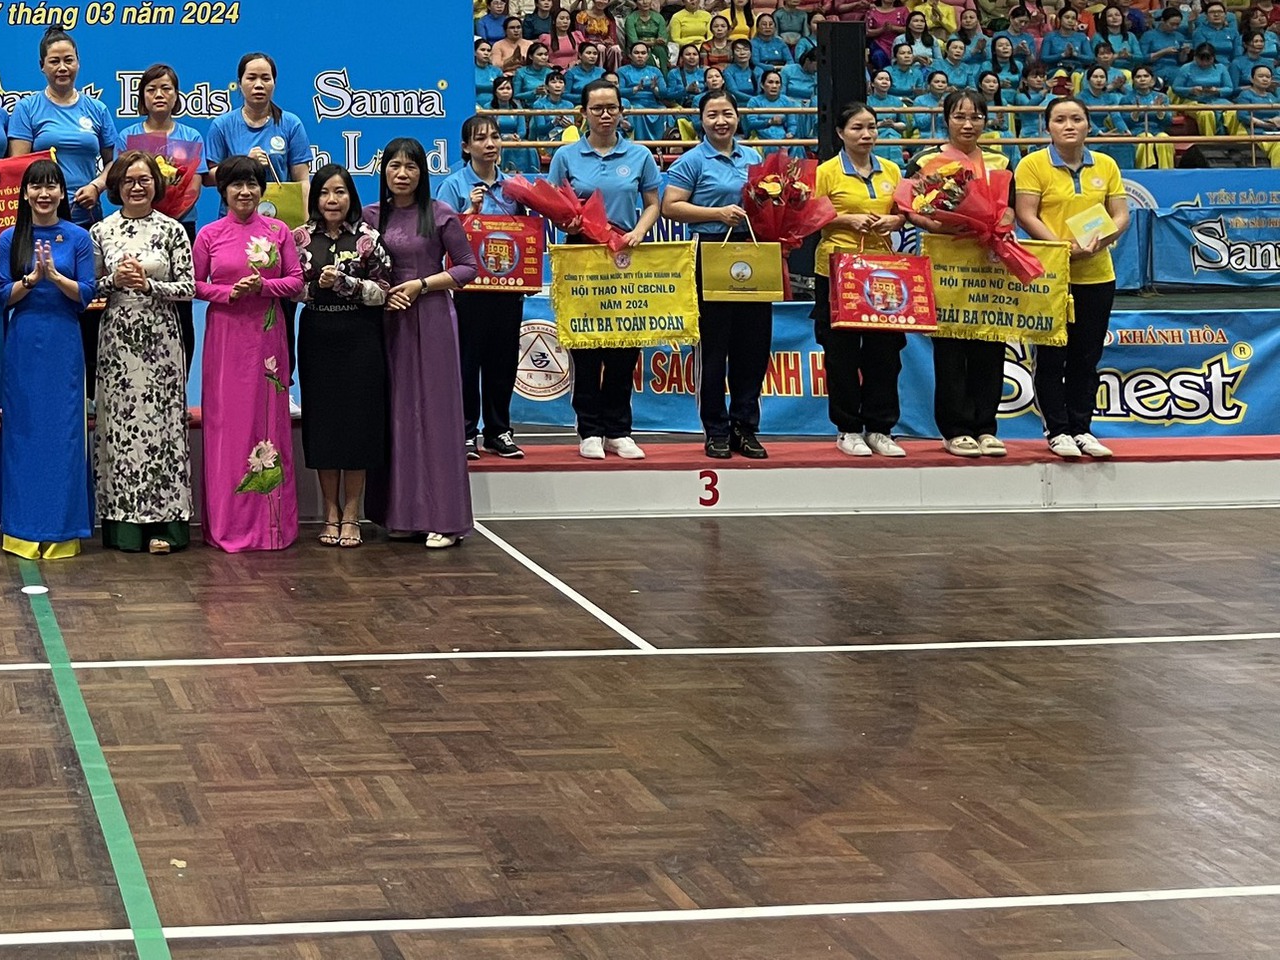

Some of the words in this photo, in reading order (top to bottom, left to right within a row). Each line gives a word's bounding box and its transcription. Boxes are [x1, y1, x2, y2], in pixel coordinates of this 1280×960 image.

[7, 0, 79, 30] tháng
[85, 2, 117, 24] 03
[121, 1, 175, 25] năm
[180, 1, 241, 25] 2024
[313, 68, 446, 123] Sanna
[0, 215, 16, 228] 202
[1190, 215, 1280, 274] San
[571, 285, 588, 298] HỘI
[592, 285, 617, 296] THAO
[621, 282, 635, 294] NỮ
[637, 284, 676, 293] CBCNLĐ
[939, 277, 958, 289] HỘI
[962, 279, 986, 288] THAO
[989, 277, 1005, 289] NỮ
[600, 299, 622, 310] NĂM
[626, 299, 648, 309] 2024
[968, 293, 989, 303] NĂM
[991, 295, 1019, 306] 2024
[570, 312, 595, 333] GIẢI
[597, 317, 613, 332] BA
[615, 312, 646, 332] TOÀN
[649, 312, 684, 331] ĐOÀN
[963, 309, 979, 325] BA
[981, 308, 1014, 327] TOÀN
[1017, 312, 1054, 331] ĐOÀN
[1118, 325, 1184, 346] KHÁNH
[1188, 325, 1228, 345] HÒA
[699, 470, 720, 507] 3
